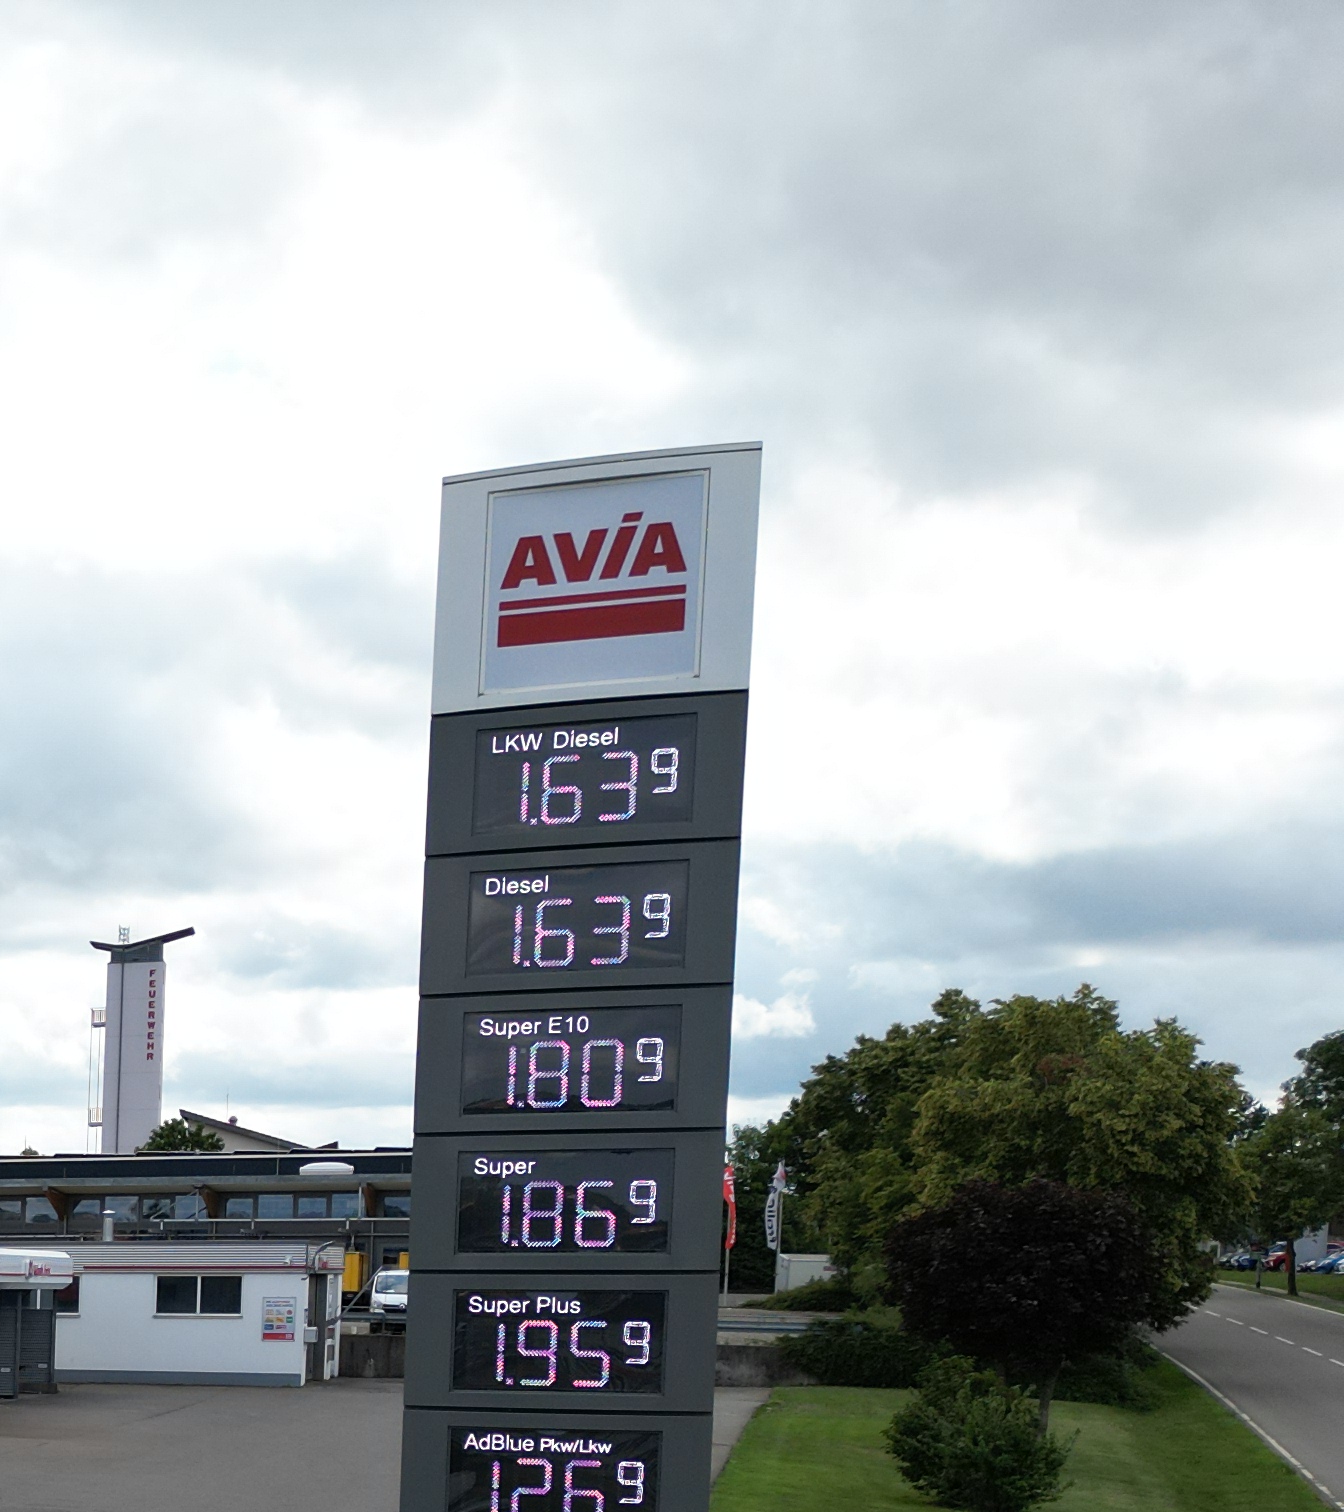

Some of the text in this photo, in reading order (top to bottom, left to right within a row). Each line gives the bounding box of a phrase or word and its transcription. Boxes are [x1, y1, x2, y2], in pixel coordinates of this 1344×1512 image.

[500, 511, 687, 590] AVIA
[491, 726, 620, 754] LKW Diesel
[484, 875, 550, 897] Diesel
[147, 969, 156, 1060] FEUERWEHR
[479, 1016, 590, 1039] Super E10
[473, 1158, 536, 1178] Super
[468, 1296, 582, 1318] Super Plus
[463, 1433, 613, 1456] AdBlue Pkw/Lkw
